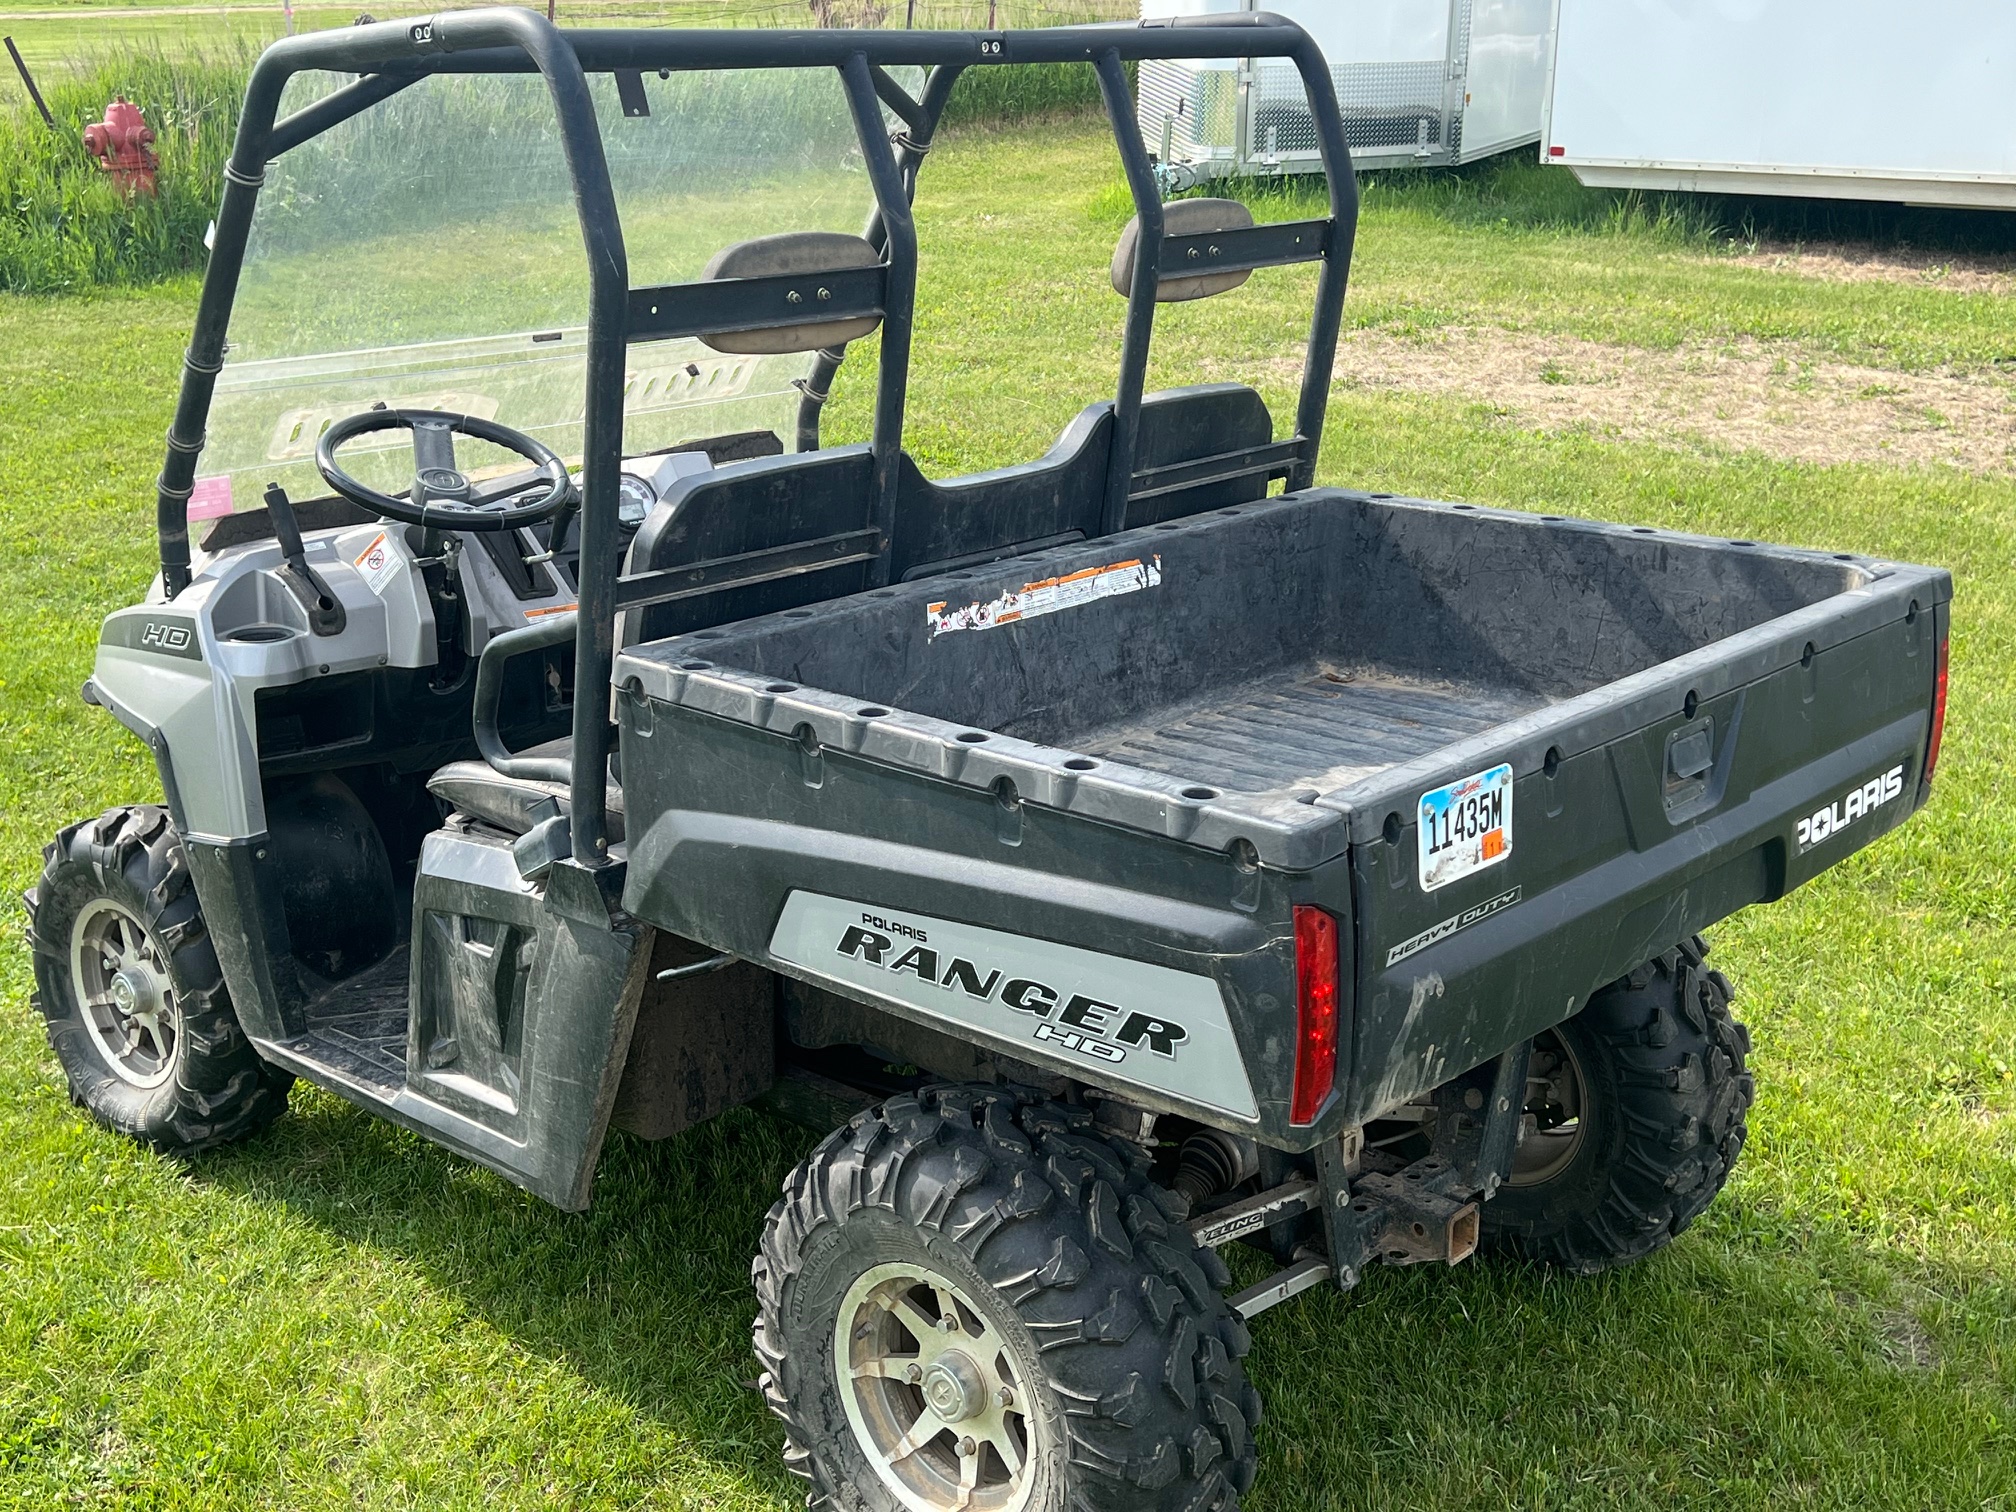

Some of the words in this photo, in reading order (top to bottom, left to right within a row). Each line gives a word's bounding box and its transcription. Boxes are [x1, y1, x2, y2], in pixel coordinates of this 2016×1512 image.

[142, 623, 191, 650] HD
[1429, 787, 1503, 855] 11435M
[1797, 764, 1903, 854] POLARIS
[862, 912, 927, 943] POLARIS
[1390, 921, 1455, 960] HEAVY
[1461, 891, 1516, 924] DUTY
[835, 923, 1190, 1061] RANGER
[1033, 1023, 1127, 1063] HD
